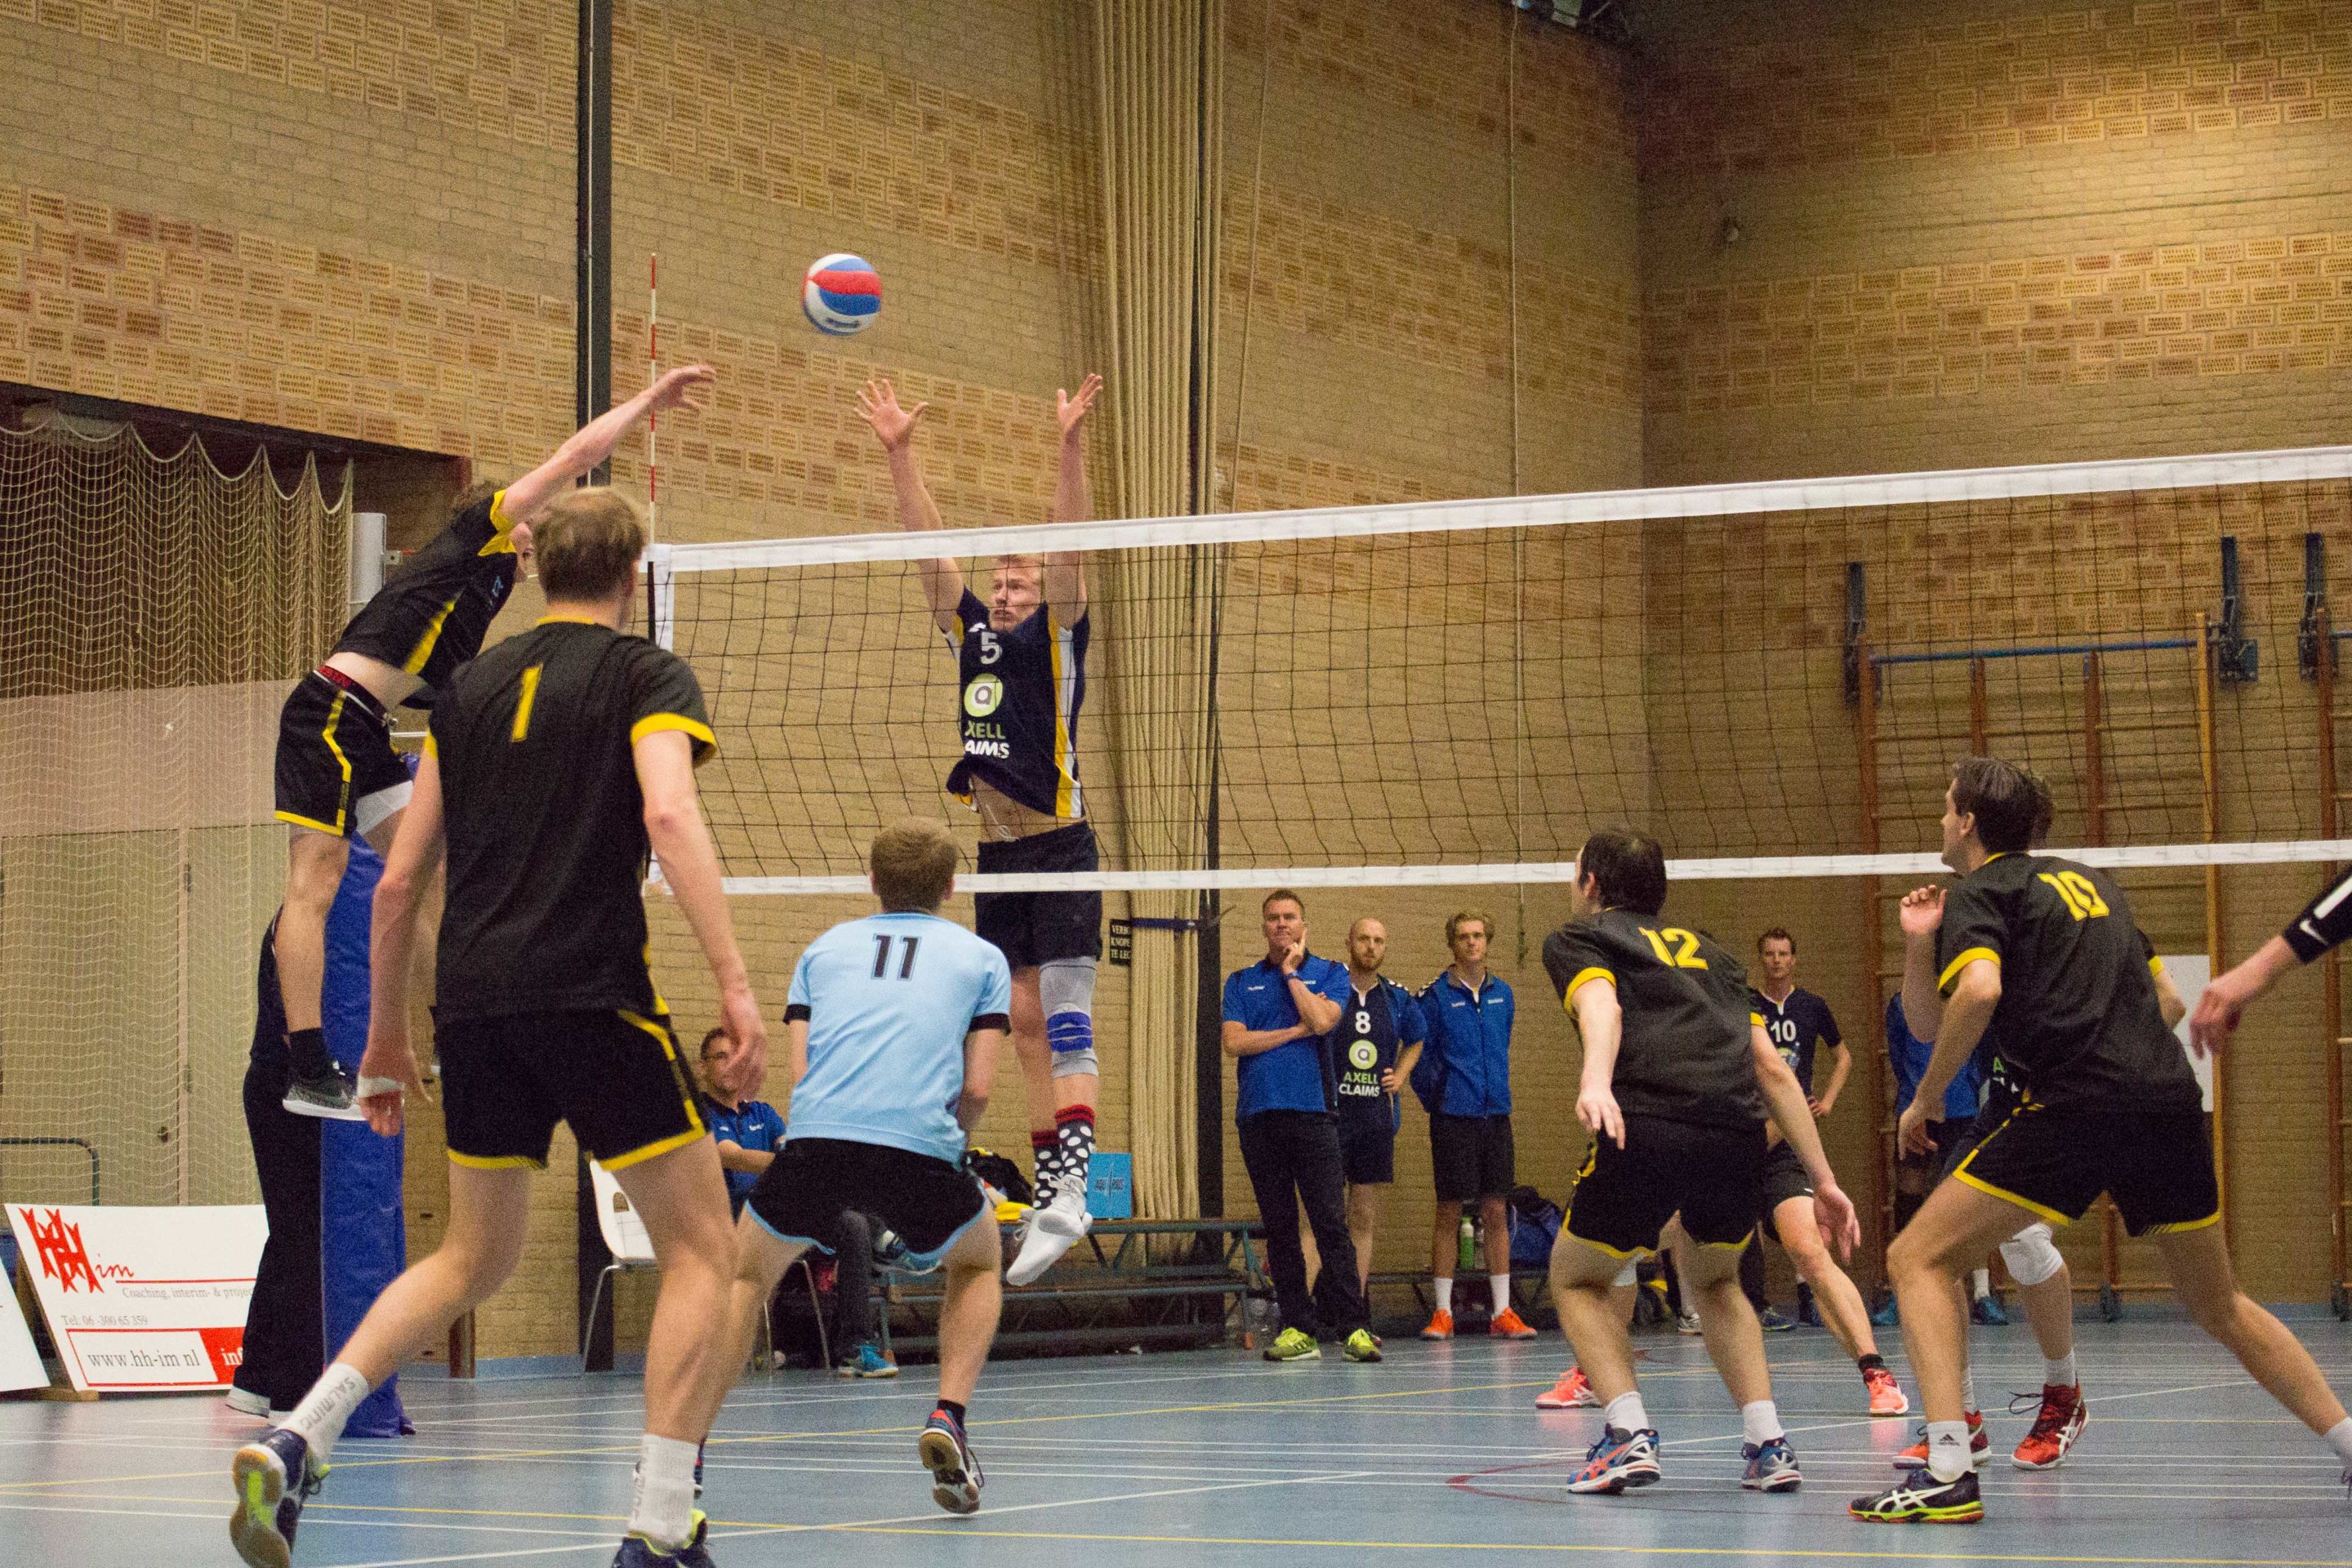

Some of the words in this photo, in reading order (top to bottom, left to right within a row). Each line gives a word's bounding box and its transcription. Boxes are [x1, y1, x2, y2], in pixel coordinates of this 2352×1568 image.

[980, 631, 1003, 665] 5
[510, 662, 544, 743] 1
[2037, 871, 2110, 921] 10
[871, 933, 922, 982] 11
[1638, 926, 1709, 970] 12
[1356, 1011, 1371, 1034] 8
[1770, 1019, 1797, 1043] 10
[1343, 1071, 1379, 1085] AXELL
[1339, 1083, 1380, 1098] CLAIMS
[122, 1286, 171, 1300] Coaching,
[213, 1287, 220, 1297] &
[82, 1315, 95, 1326] 06
[118, 1315, 131, 1326] 65
